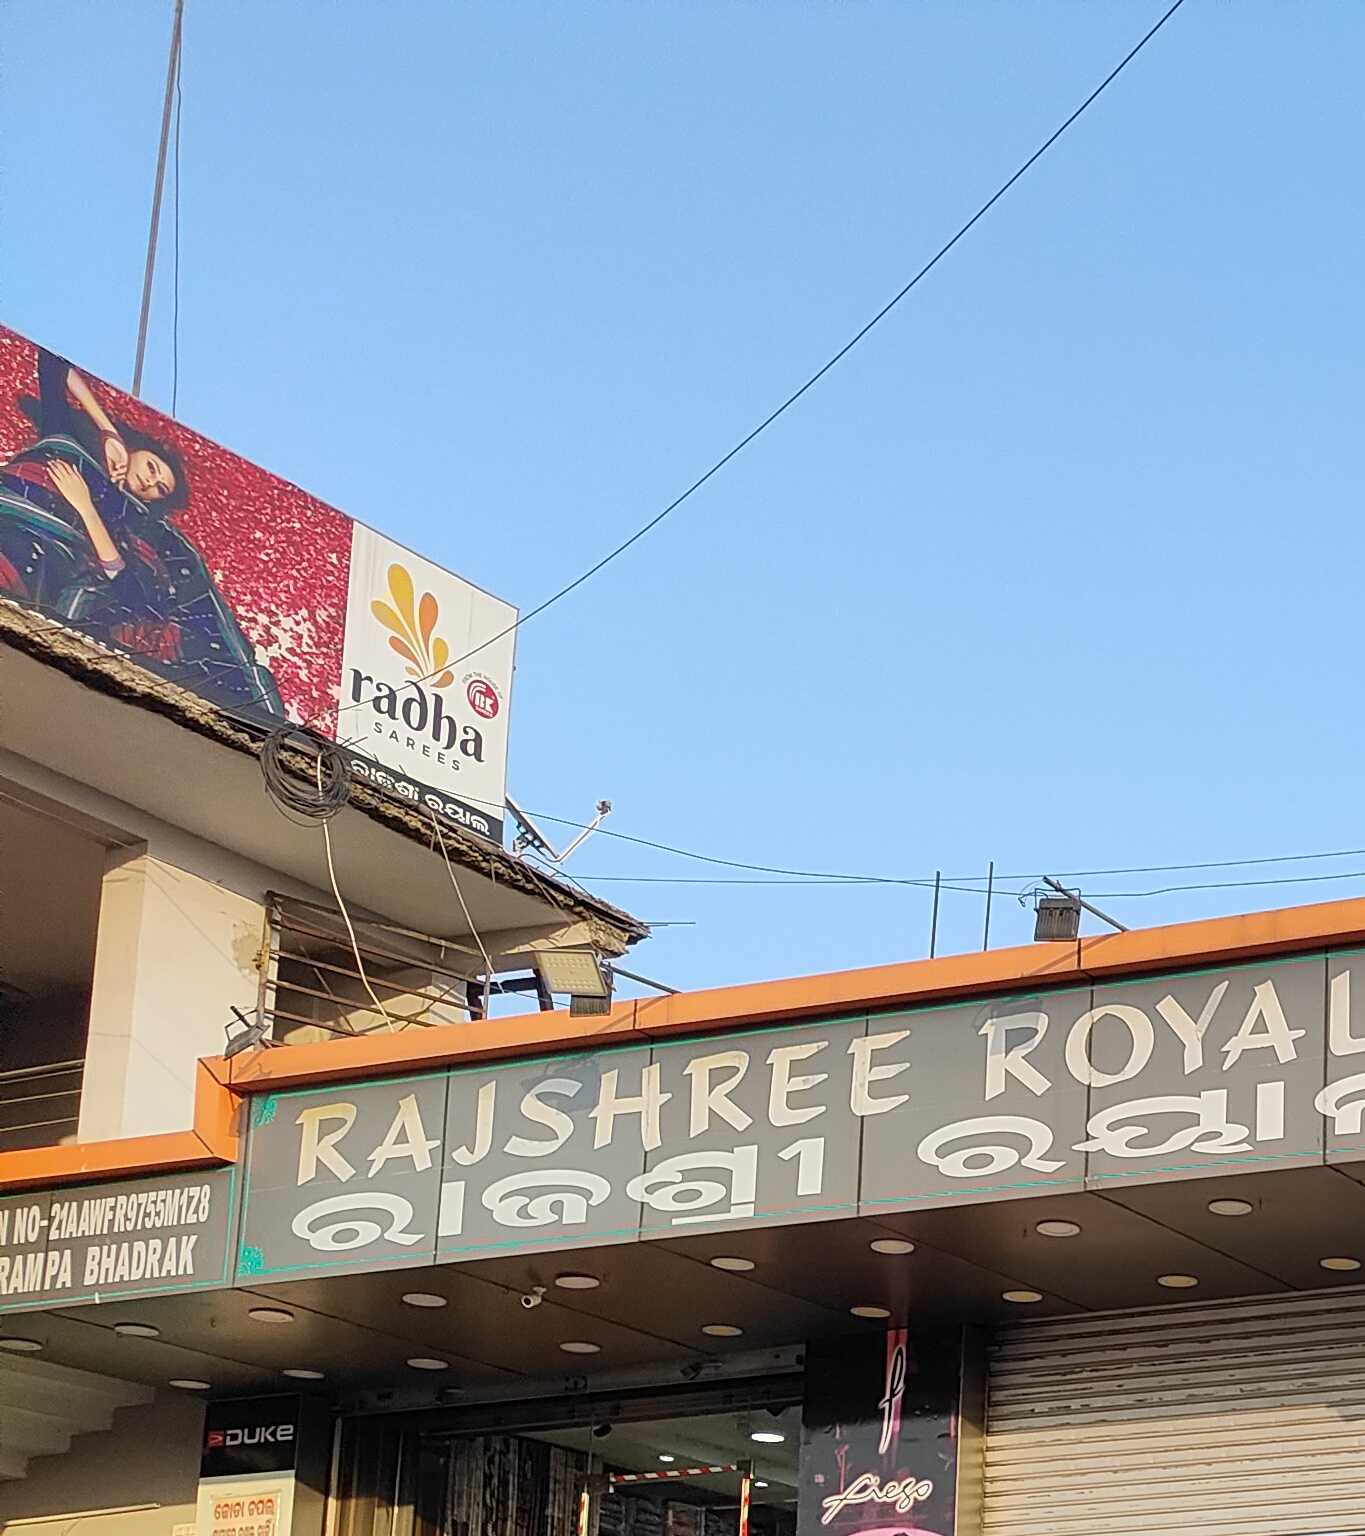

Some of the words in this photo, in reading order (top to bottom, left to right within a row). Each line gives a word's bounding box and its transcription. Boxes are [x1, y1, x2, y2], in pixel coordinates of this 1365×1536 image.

[350, 668, 485, 763] radha
[373, 722, 460, 771] SAREES
[296, 1030, 911, 1186] RAJSHREE
[292, 1139, 824, 1251] ରାଜଶ୍ରୀ
[84, 1235, 198, 1286] BHADRAK
[226, 1424, 294, 1446] DUKE
